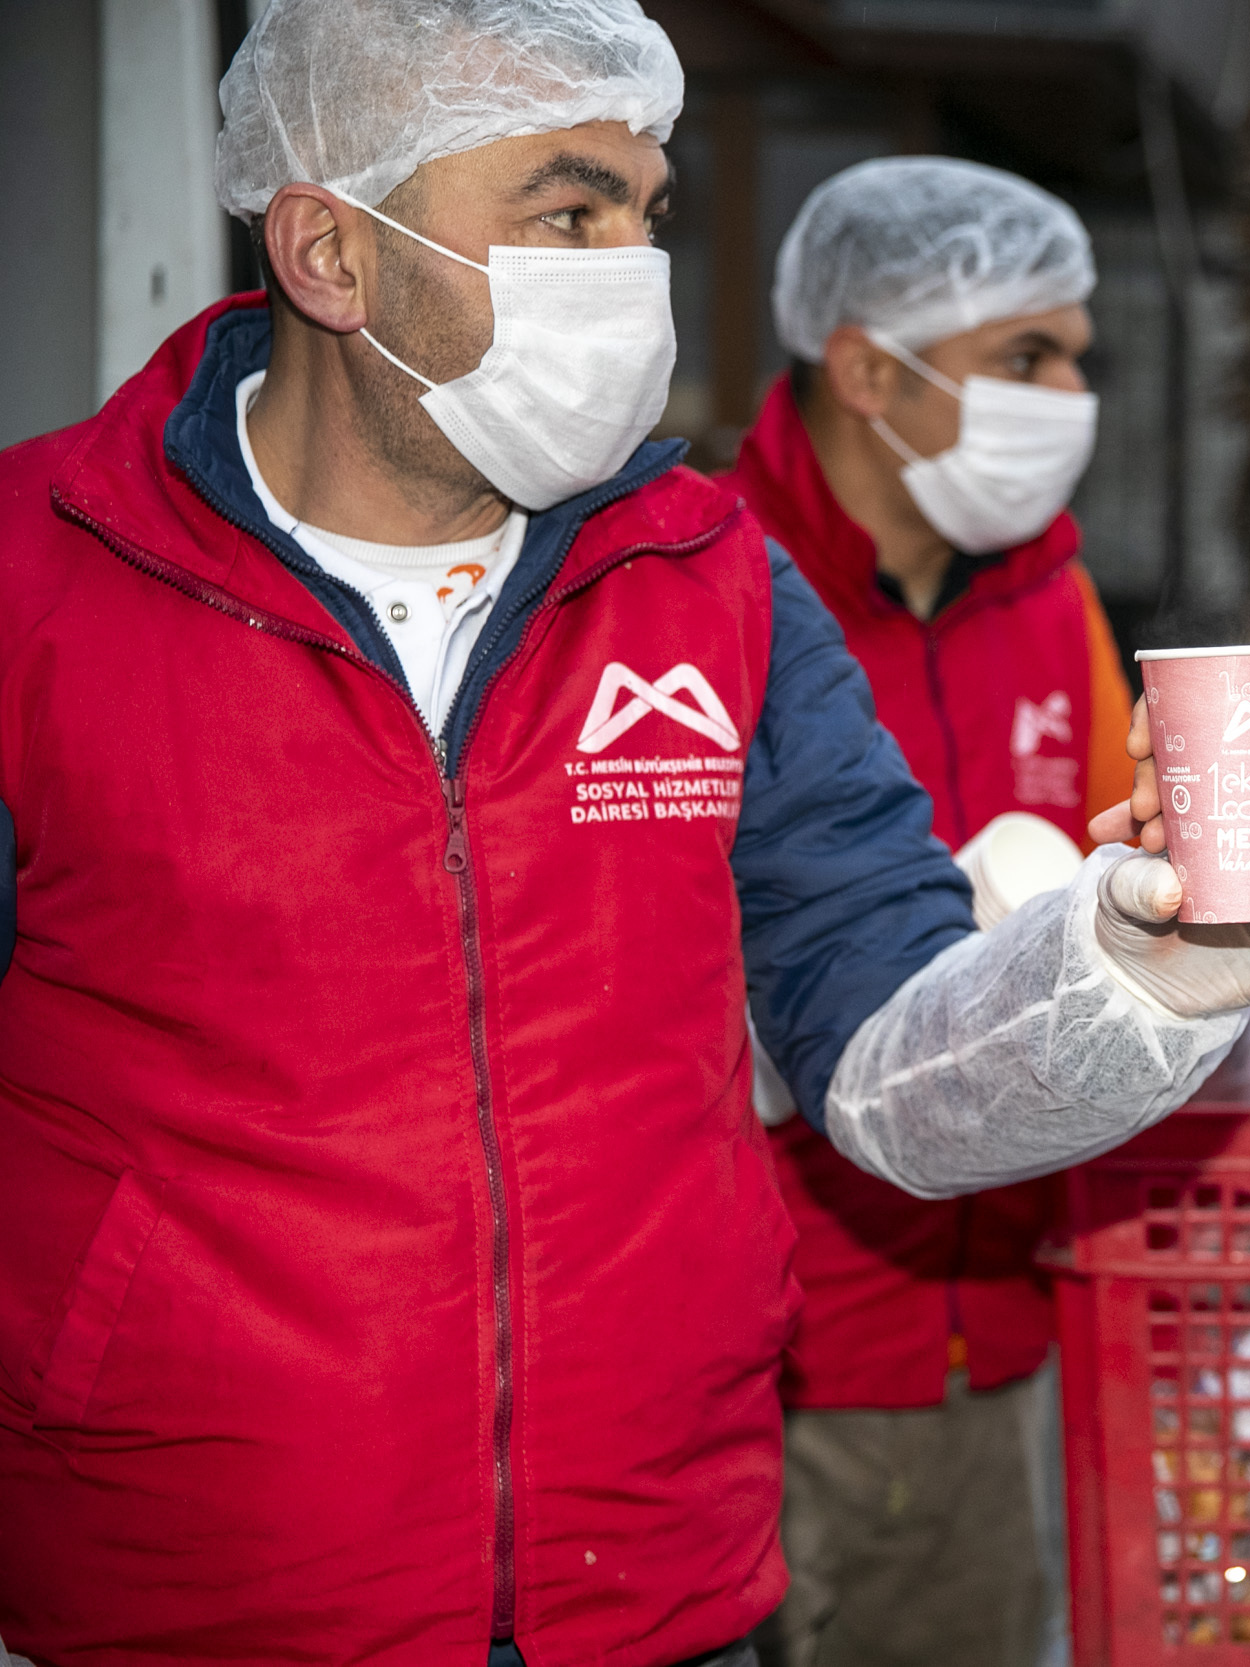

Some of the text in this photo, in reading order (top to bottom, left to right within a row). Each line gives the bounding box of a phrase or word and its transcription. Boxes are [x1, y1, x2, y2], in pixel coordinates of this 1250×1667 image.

[565, 762, 588, 776] T.C.
[591, 757, 633, 775] MERSİN
[576, 781, 650, 802] SOSYAL
[570, 801, 650, 824] DAİRESİ
